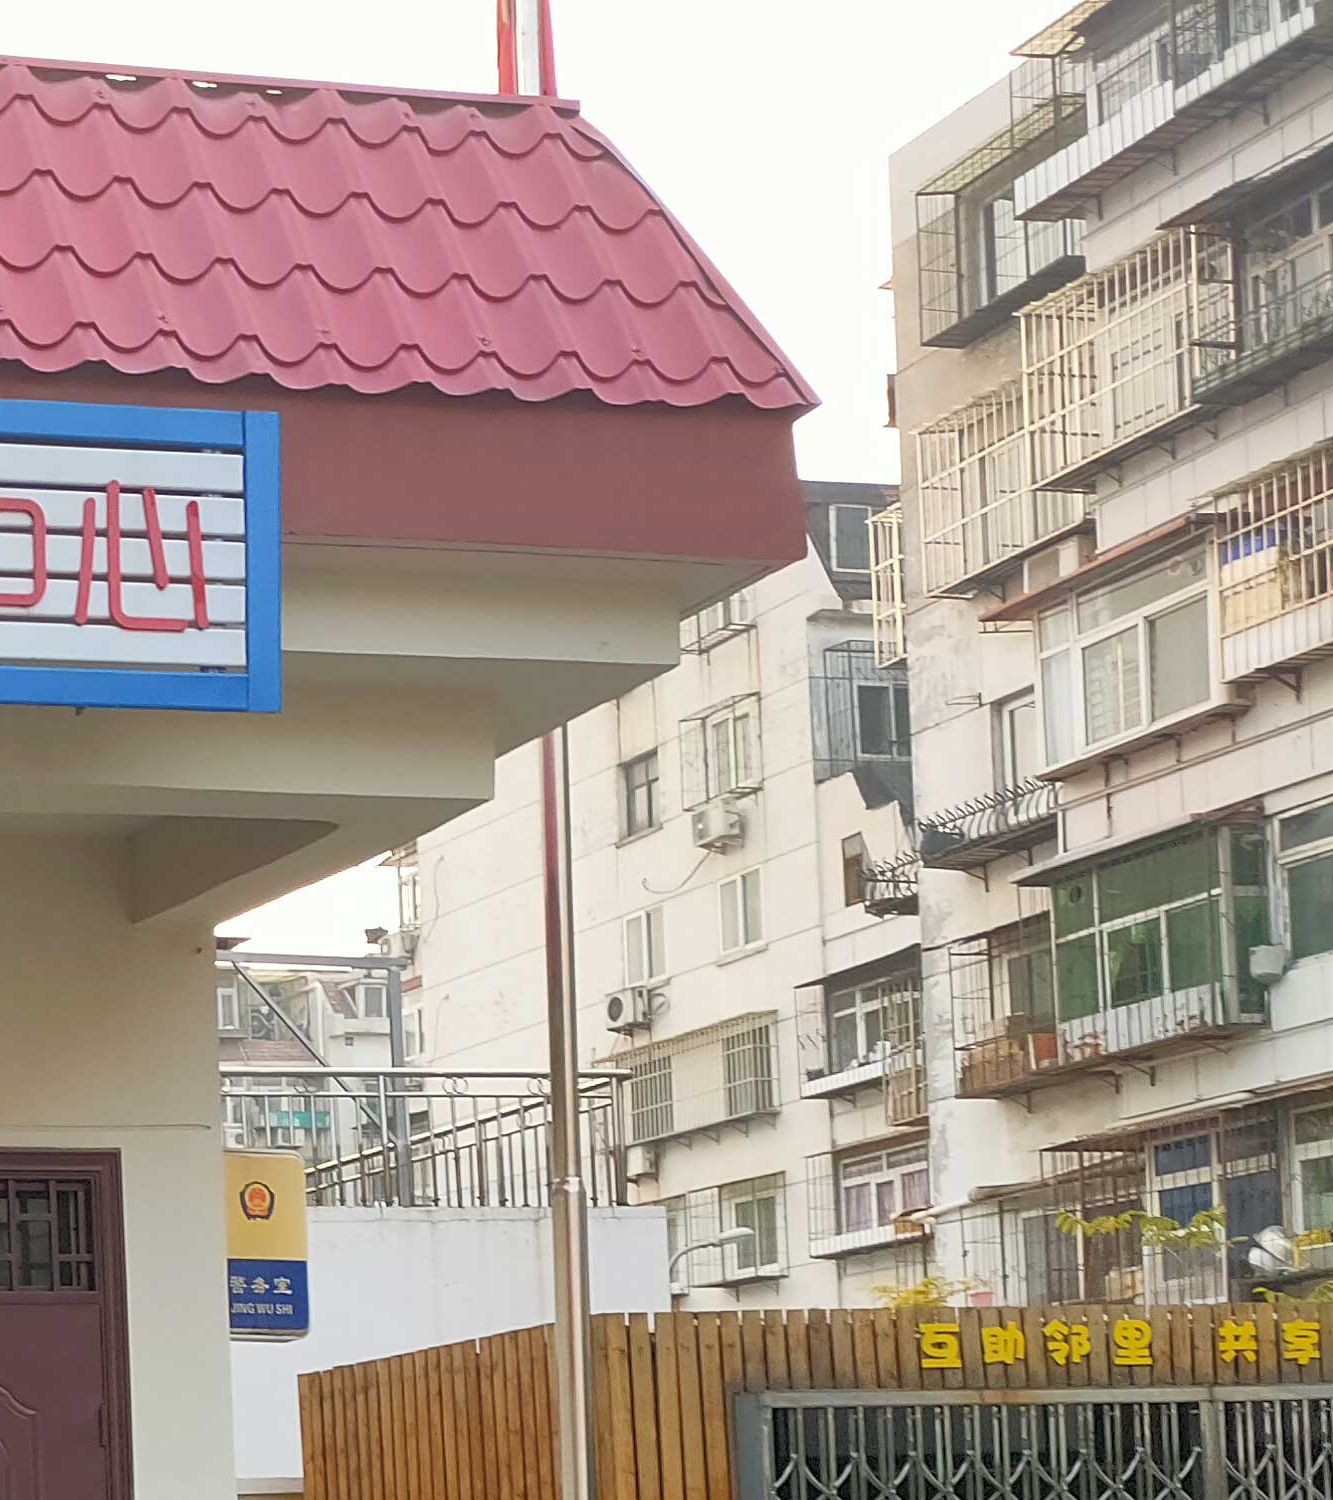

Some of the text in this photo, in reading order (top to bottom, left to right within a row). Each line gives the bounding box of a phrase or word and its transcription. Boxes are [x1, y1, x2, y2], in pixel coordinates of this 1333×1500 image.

[275, 1303, 294, 1315] SHI
[919, 1318, 1321, 1369] 互助邻里 共享
